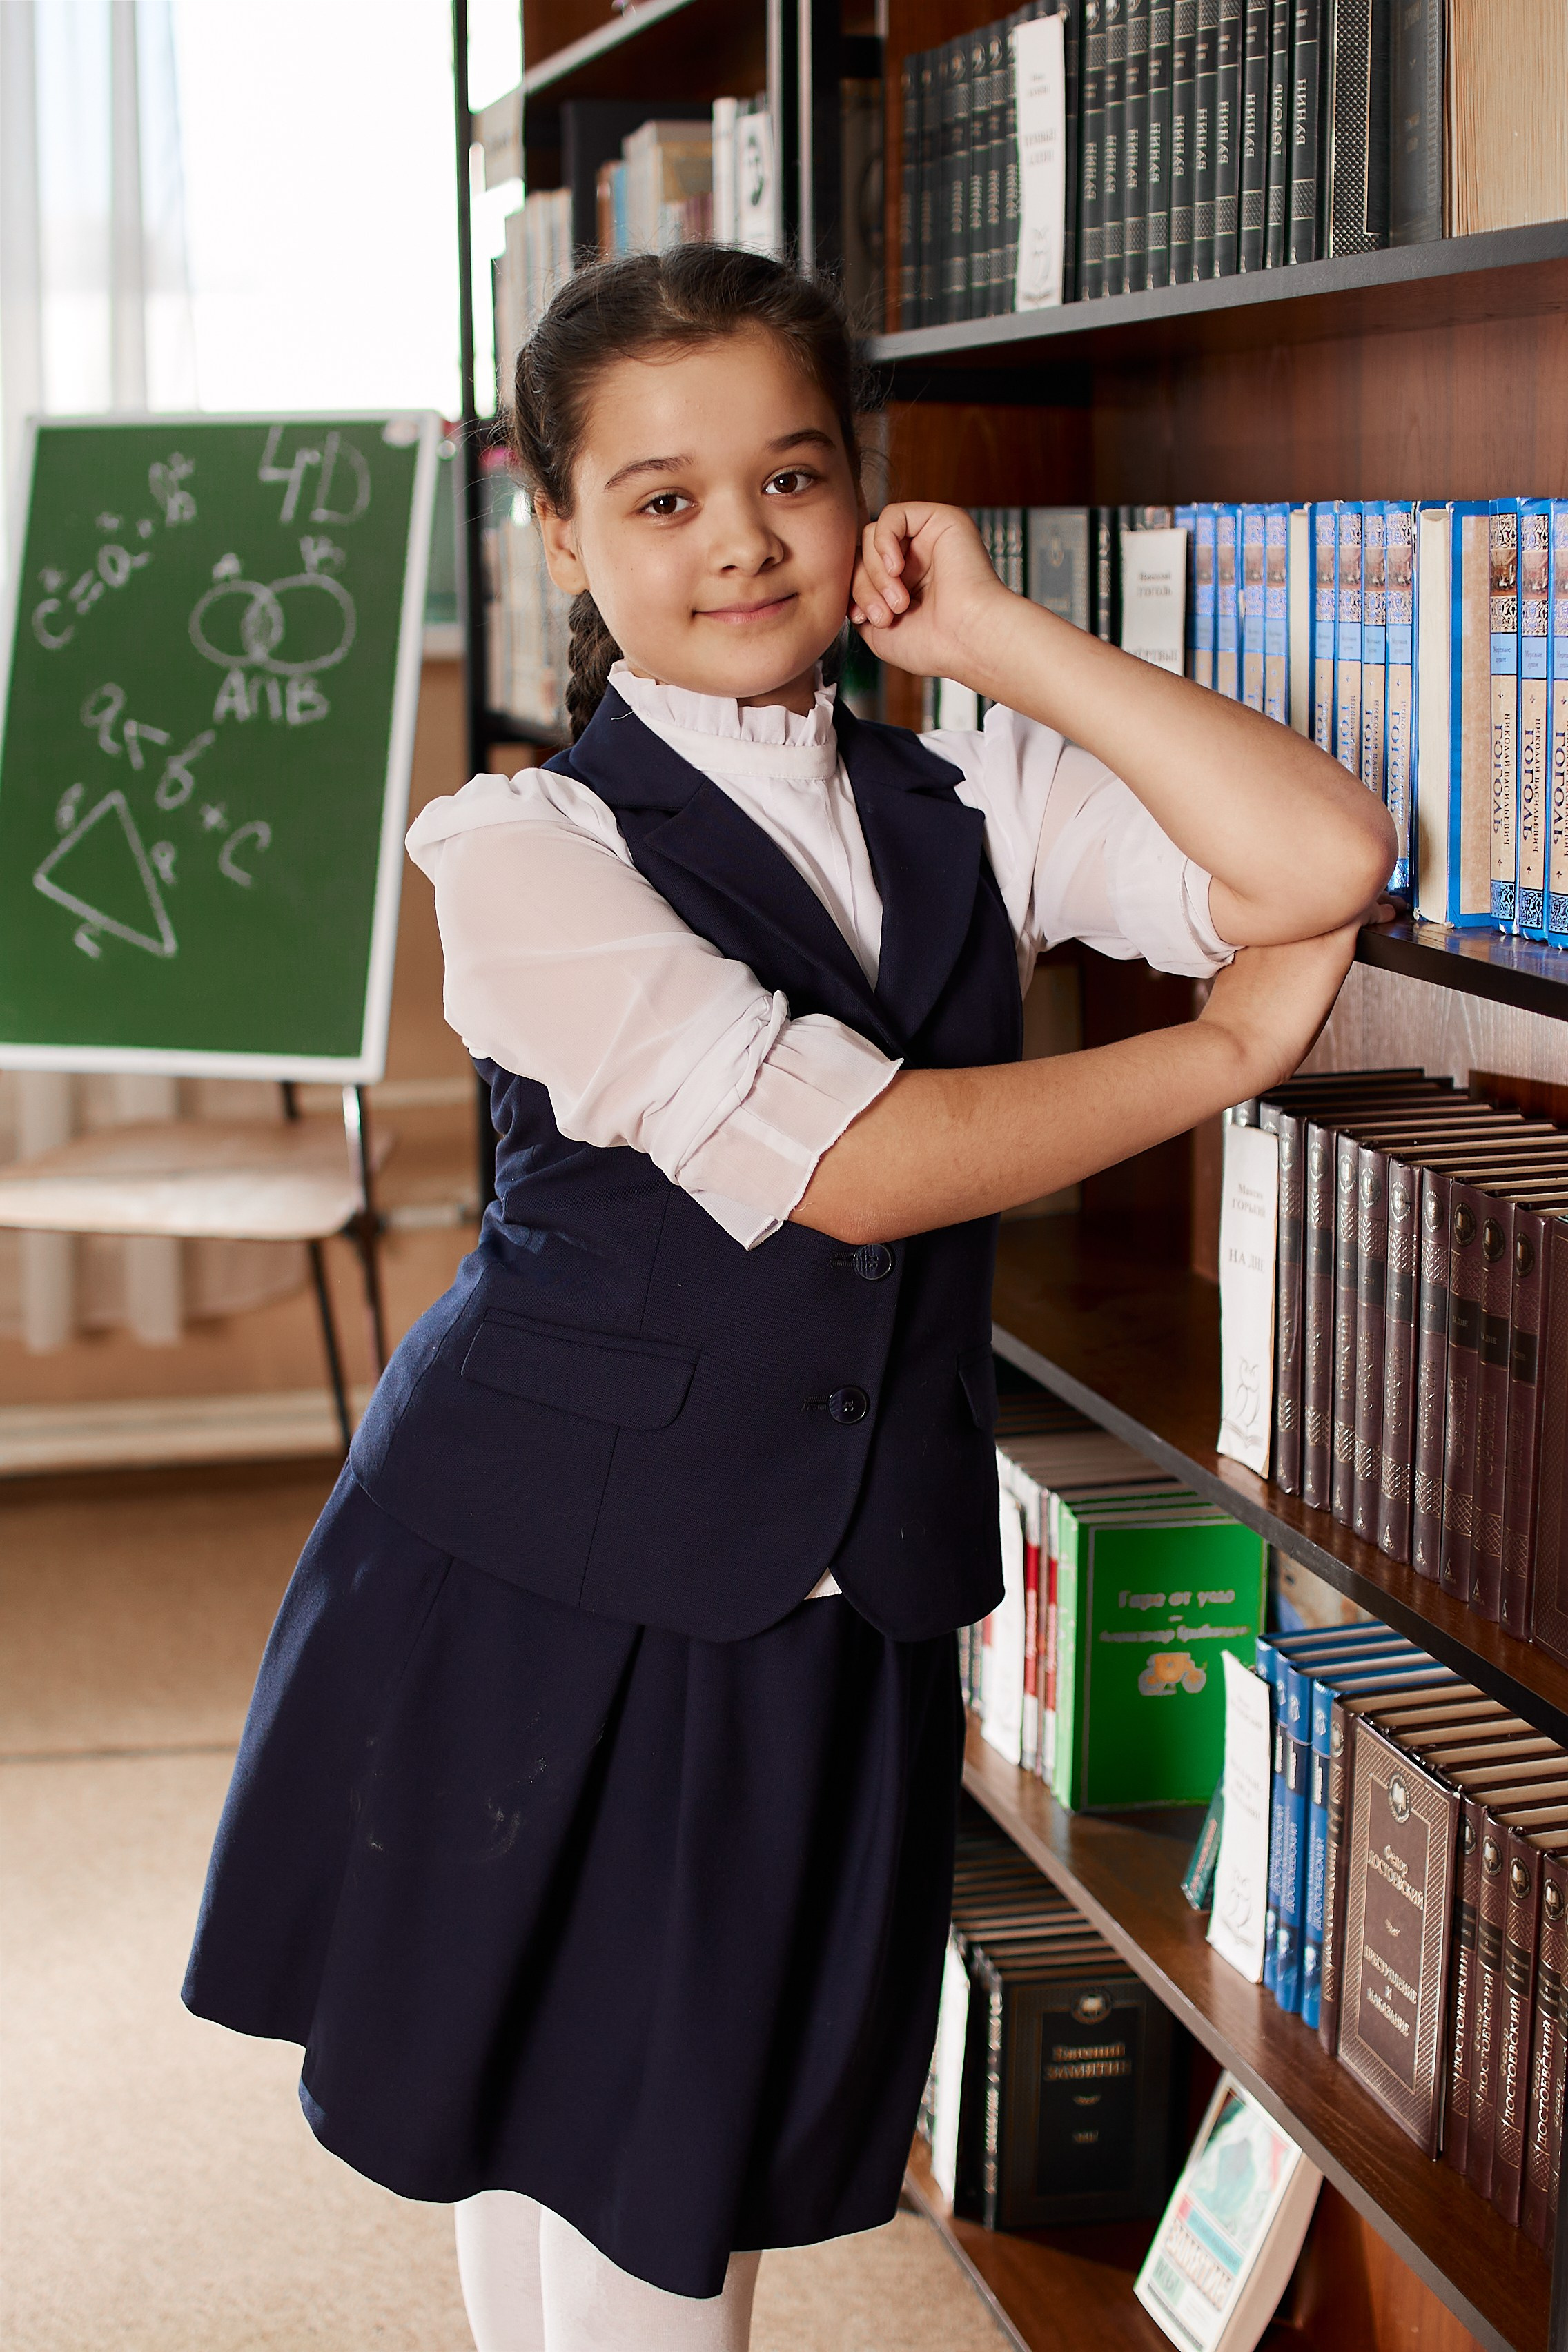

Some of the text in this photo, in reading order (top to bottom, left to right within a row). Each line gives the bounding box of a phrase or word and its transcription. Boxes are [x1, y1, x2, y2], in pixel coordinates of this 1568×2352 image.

[1173, 115, 1184, 176] БУНИН
[1196, 108, 1207, 170] БУНИН
[1218, 101, 1229, 164] БУНИН
[1245, 94, 1255, 158] БУНИН
[1272, 84, 1282, 155] ГОГОЛЬ
[1296, 79, 1306, 145] БУНИН
[1126, 130, 1138, 188] БУНИН
[1150, 123, 1160, 182] БУНИН
[1391, 711, 1400, 813] ГОГОЛЬ
[1493, 725, 1503, 834] ГОГОЛЬ
[1522, 729, 1535, 841] ГОГОЛЬ
[1554, 732, 1566, 845] ГОГОЛЬ
[1229, 1248, 1246, 1265] НА
[1391, 1347, 1405, 1435] ГОРЬКИЙ
[1422, 1360, 1436, 1450] ГОРЬКИЙ
[1453, 1375, 1468, 1469] ГОРЬКИЙ
[1482, 1393, 1497, 1489] ГОРЬКИЙ
[1367, 1849, 1424, 1911] ДОСТОЕВСКИЙ
[1364, 1944, 1418, 2005] ПРЕСТУПЛЕНИЕ
[1384, 1985, 1393, 2001] И
[1366, 1986, 1409, 2037] НАКАЗАНИЕ
[1452, 1950, 1469, 2074] ДОСТОЕВСКИЙ
[1479, 1972, 1494, 2099] ДОСТОЕВСКИЙ
[1505, 1996, 1521, 2124] ДОСТОЕВСКИЙ
[1537, 2019, 1554, 2149] ДОСТОЕВСКИЙ
